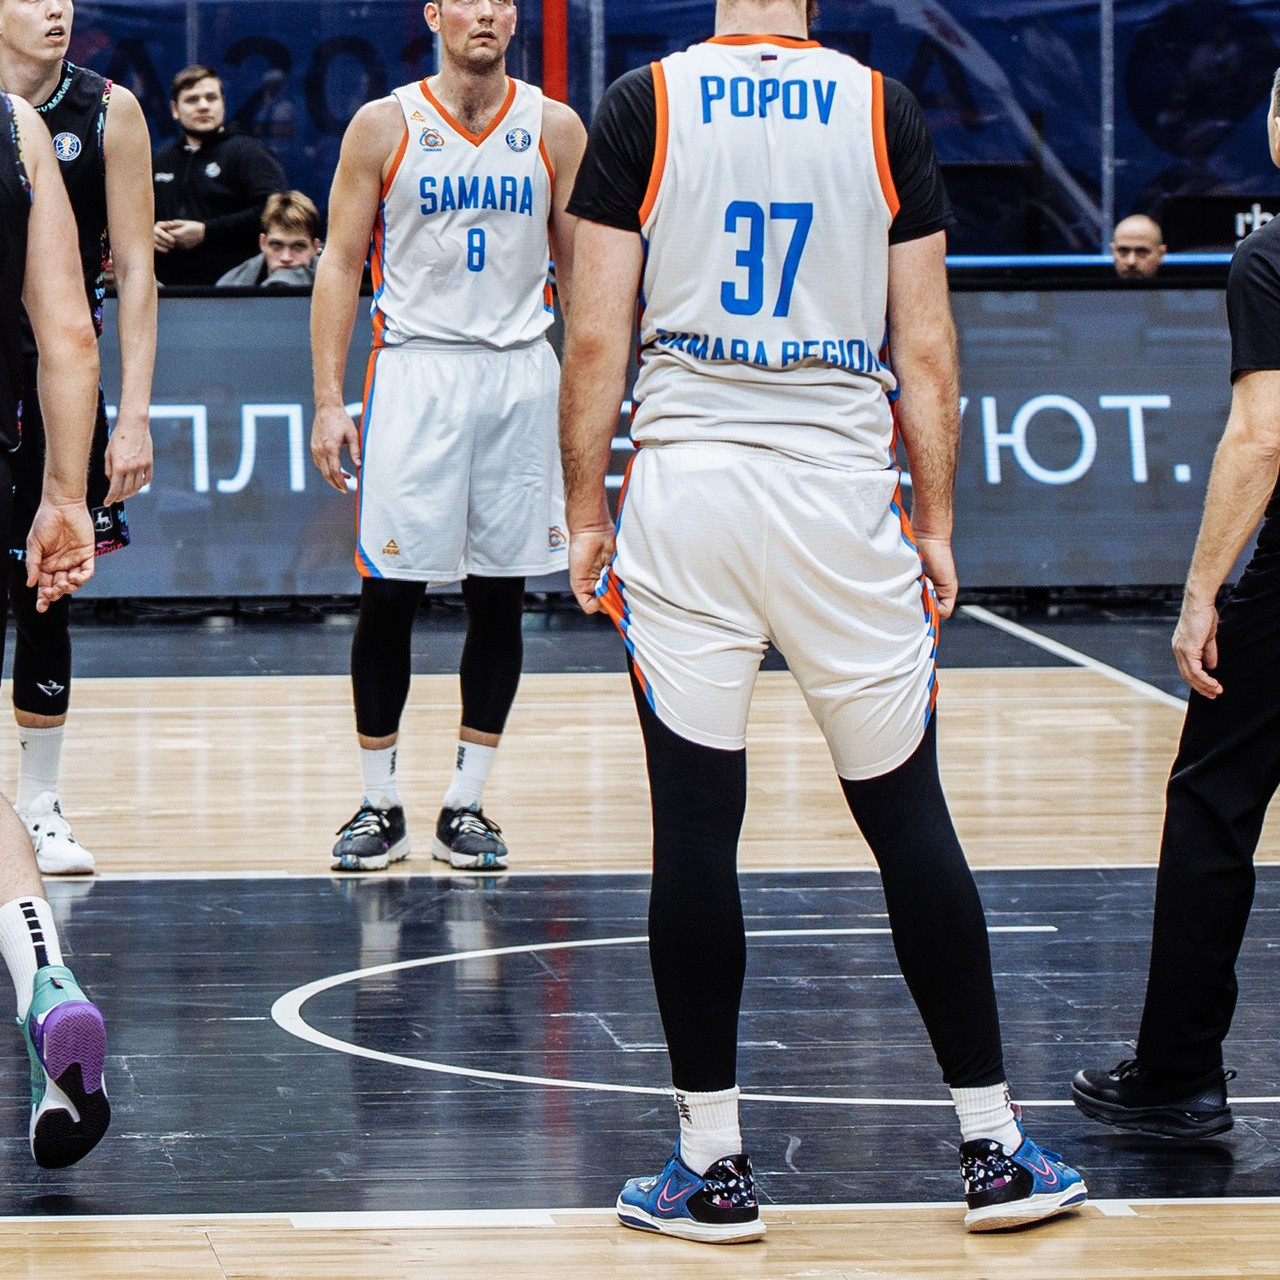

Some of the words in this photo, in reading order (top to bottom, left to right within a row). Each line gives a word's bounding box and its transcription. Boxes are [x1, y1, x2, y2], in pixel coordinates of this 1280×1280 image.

[700, 75, 837, 125] POPOV
[420, 176, 533, 217] SAMARA
[467, 227, 487, 272] 8
[720, 200, 814, 317] 37
